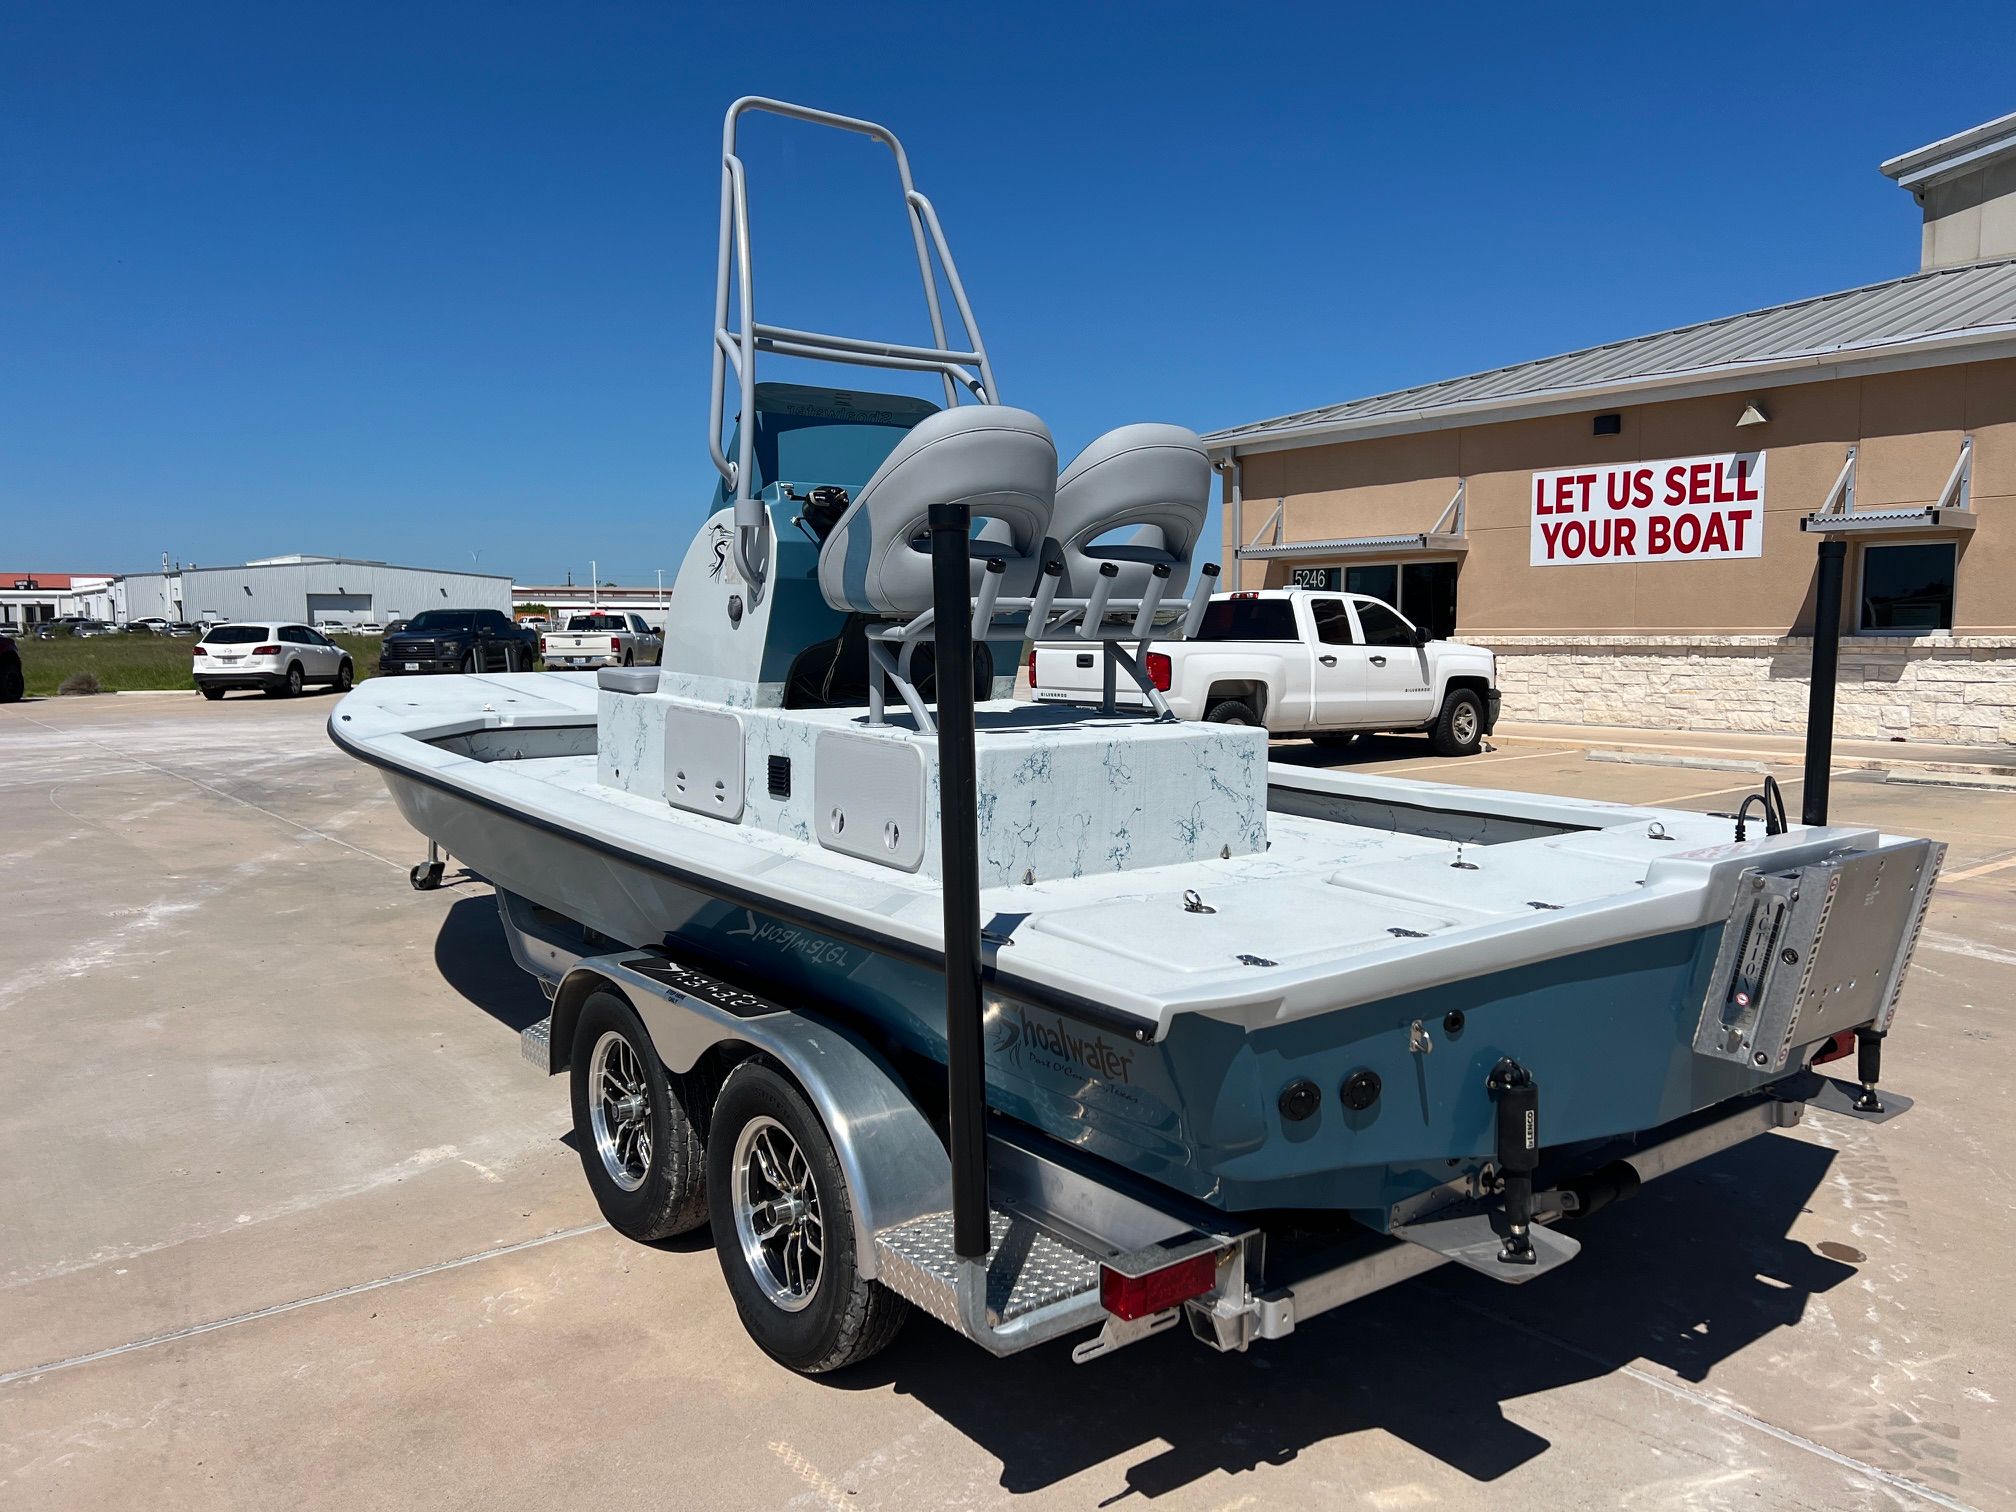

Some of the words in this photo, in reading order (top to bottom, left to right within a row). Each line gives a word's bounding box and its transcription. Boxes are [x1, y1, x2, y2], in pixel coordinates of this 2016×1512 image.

[1536, 474, 1597, 515] LET
[1607, 469, 1654, 510] US
[1663, 460, 1758, 506] SELL
[1541, 518, 1637, 559] YOUR
[1648, 510, 1752, 555] BOAT
[1295, 570, 1326, 588] 5246
[986, 1006, 1133, 1084] Shoalwater
